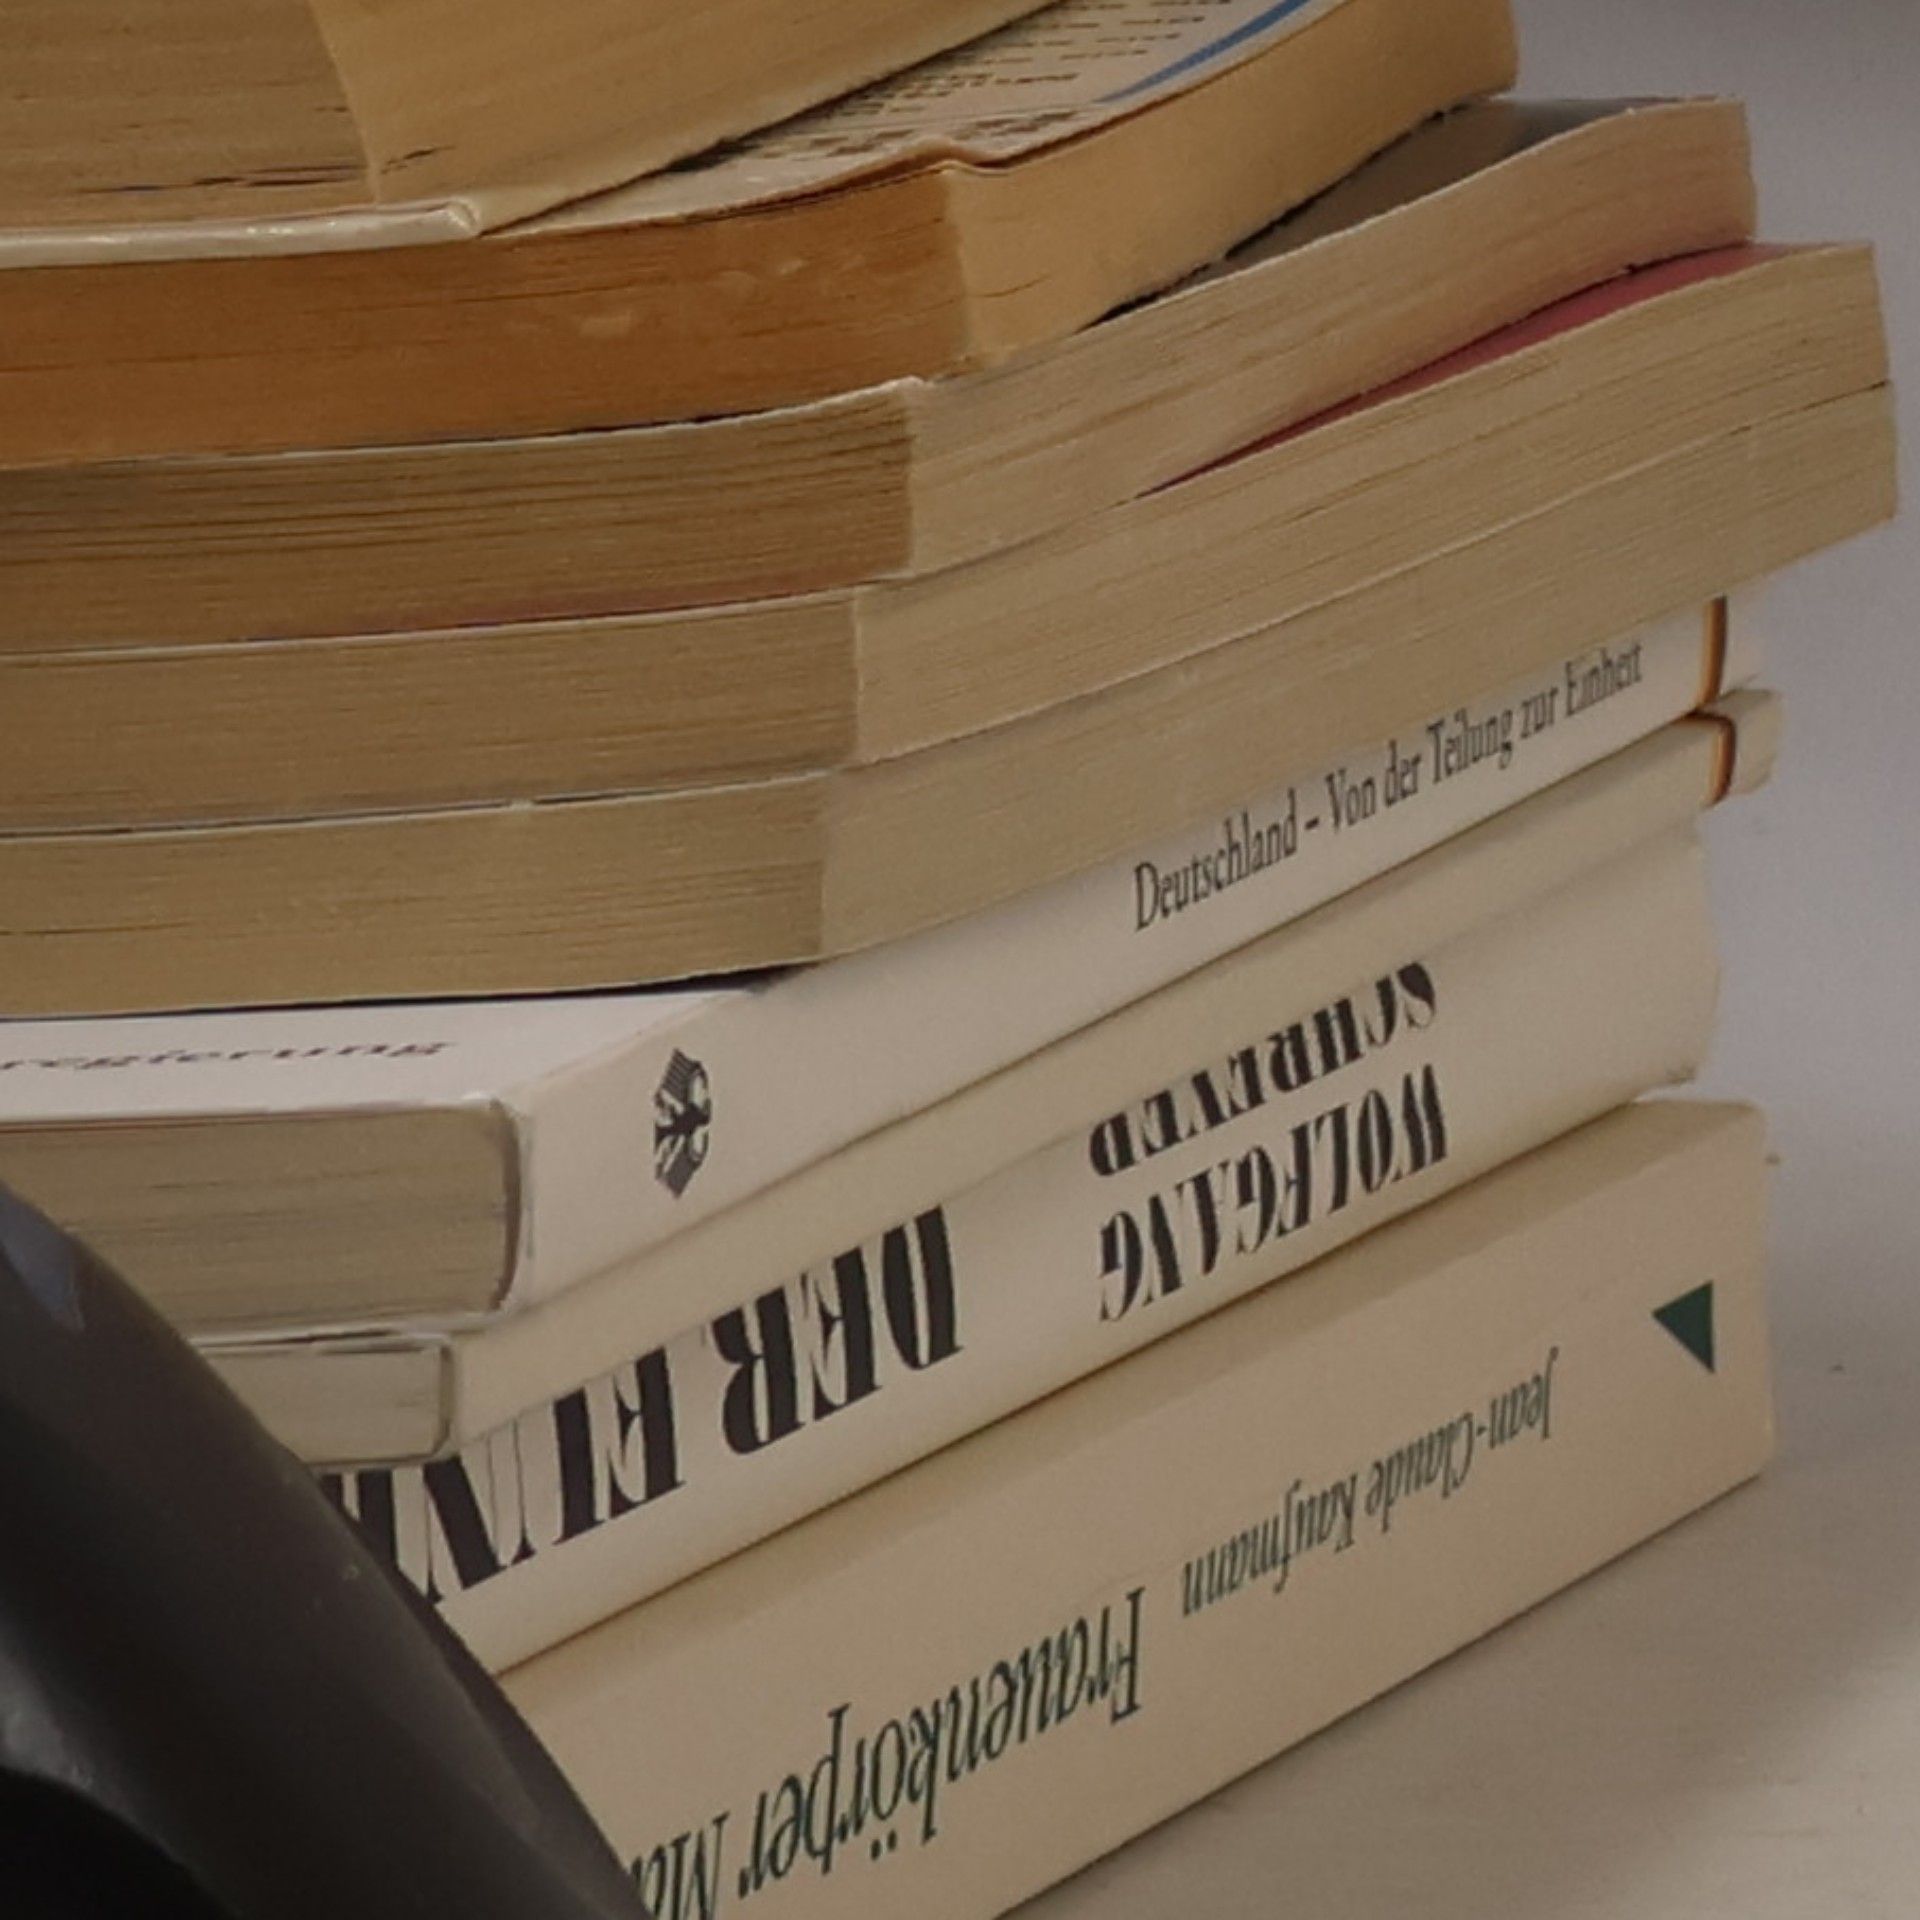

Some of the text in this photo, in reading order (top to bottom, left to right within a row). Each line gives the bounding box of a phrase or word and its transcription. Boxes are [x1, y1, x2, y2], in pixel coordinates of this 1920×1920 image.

[1134, 788, 1297, 932] Deutschland
[1324, 767, 1376, 835] Von
[1384, 739, 1423, 808] der
[1426, 708, 1514, 770] Teilung
[1519, 686, 1557, 740] zur
[1564, 642, 1644, 718] Einheit
[1097, 1063, 1448, 1322] WOLFGANG
[709, 1204, 964, 1455] DER
[1182, 1346, 1560, 1616] Jean-Claude Kaufmann
[738, 1586, 1146, 1901] Frauenkörper
